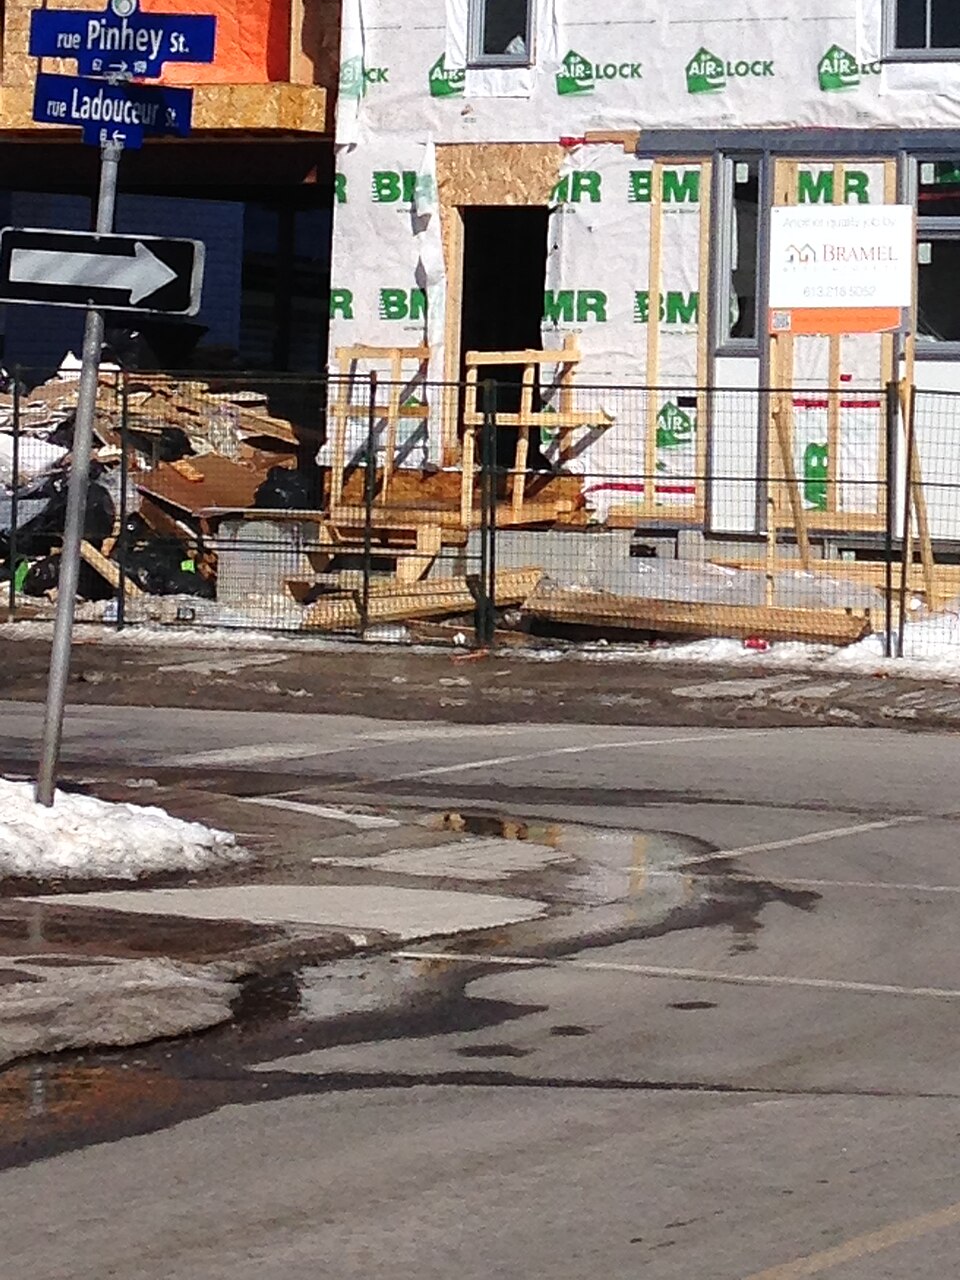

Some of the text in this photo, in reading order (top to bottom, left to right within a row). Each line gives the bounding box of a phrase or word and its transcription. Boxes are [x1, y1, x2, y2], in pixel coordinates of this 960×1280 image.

[57, 32, 81, 50] rue
[86, 18, 163, 61] Pinhey
[820, 58, 881, 75] AIR-LO
[47, 99, 67, 118] rue
[71, 86, 159, 126] Ladouceur
[627, 170, 700, 204] BM
[798, 170, 869, 204] MR
[822, 243, 898, 262] BRAMEL
[544, 289, 607, 323] MR
[633, 290, 699, 324] BM
